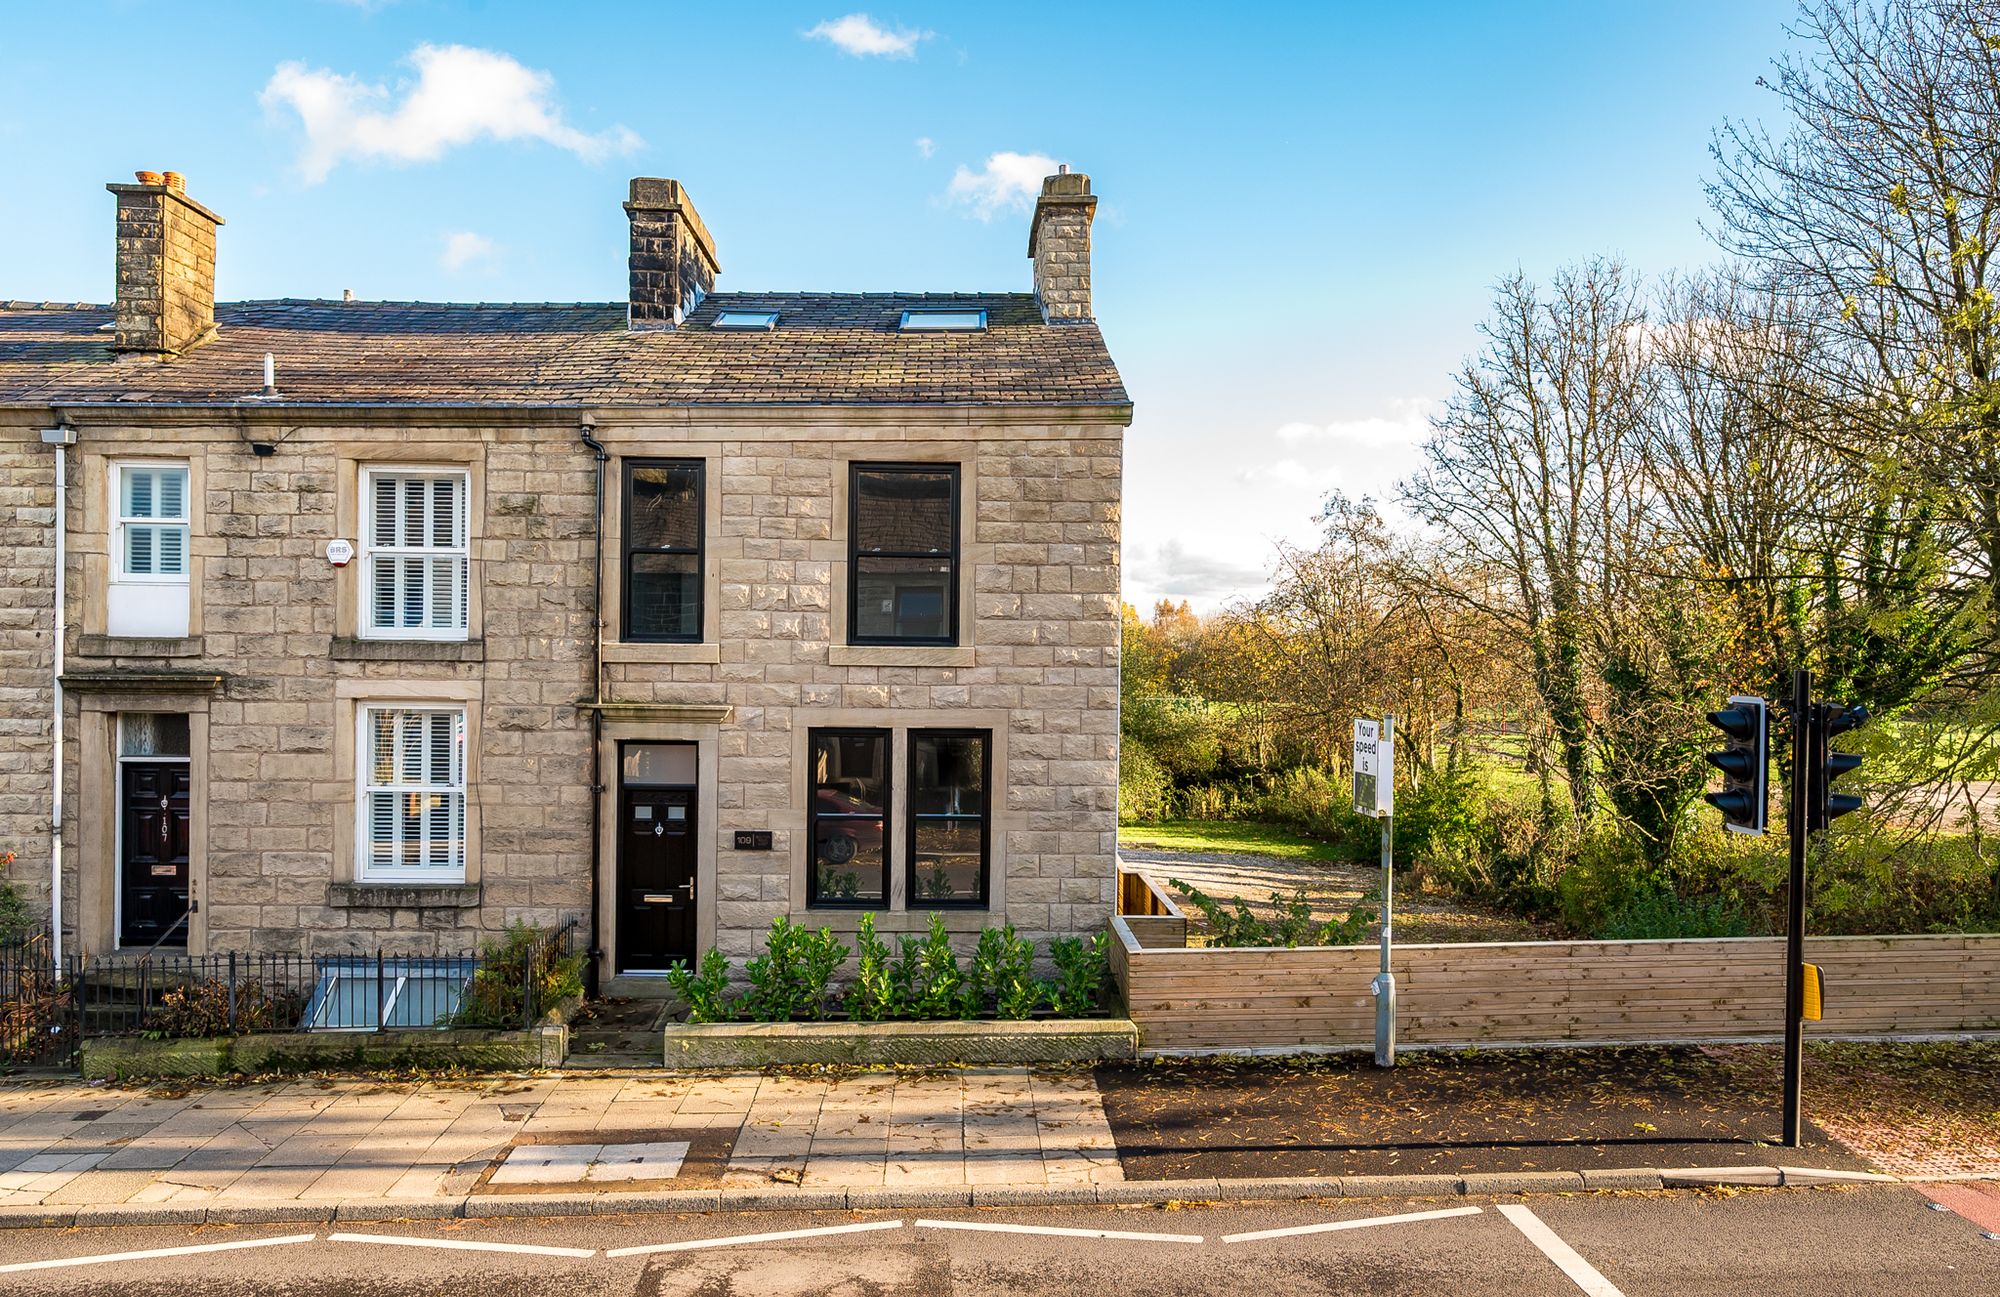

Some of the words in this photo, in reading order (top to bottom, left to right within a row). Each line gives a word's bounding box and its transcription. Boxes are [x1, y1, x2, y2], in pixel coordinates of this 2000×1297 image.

[1357, 721, 1374, 738] Your
[1355, 740, 1377, 755] speed
[1362, 757, 1369, 772] is
[737, 836, 751, 845] 109
